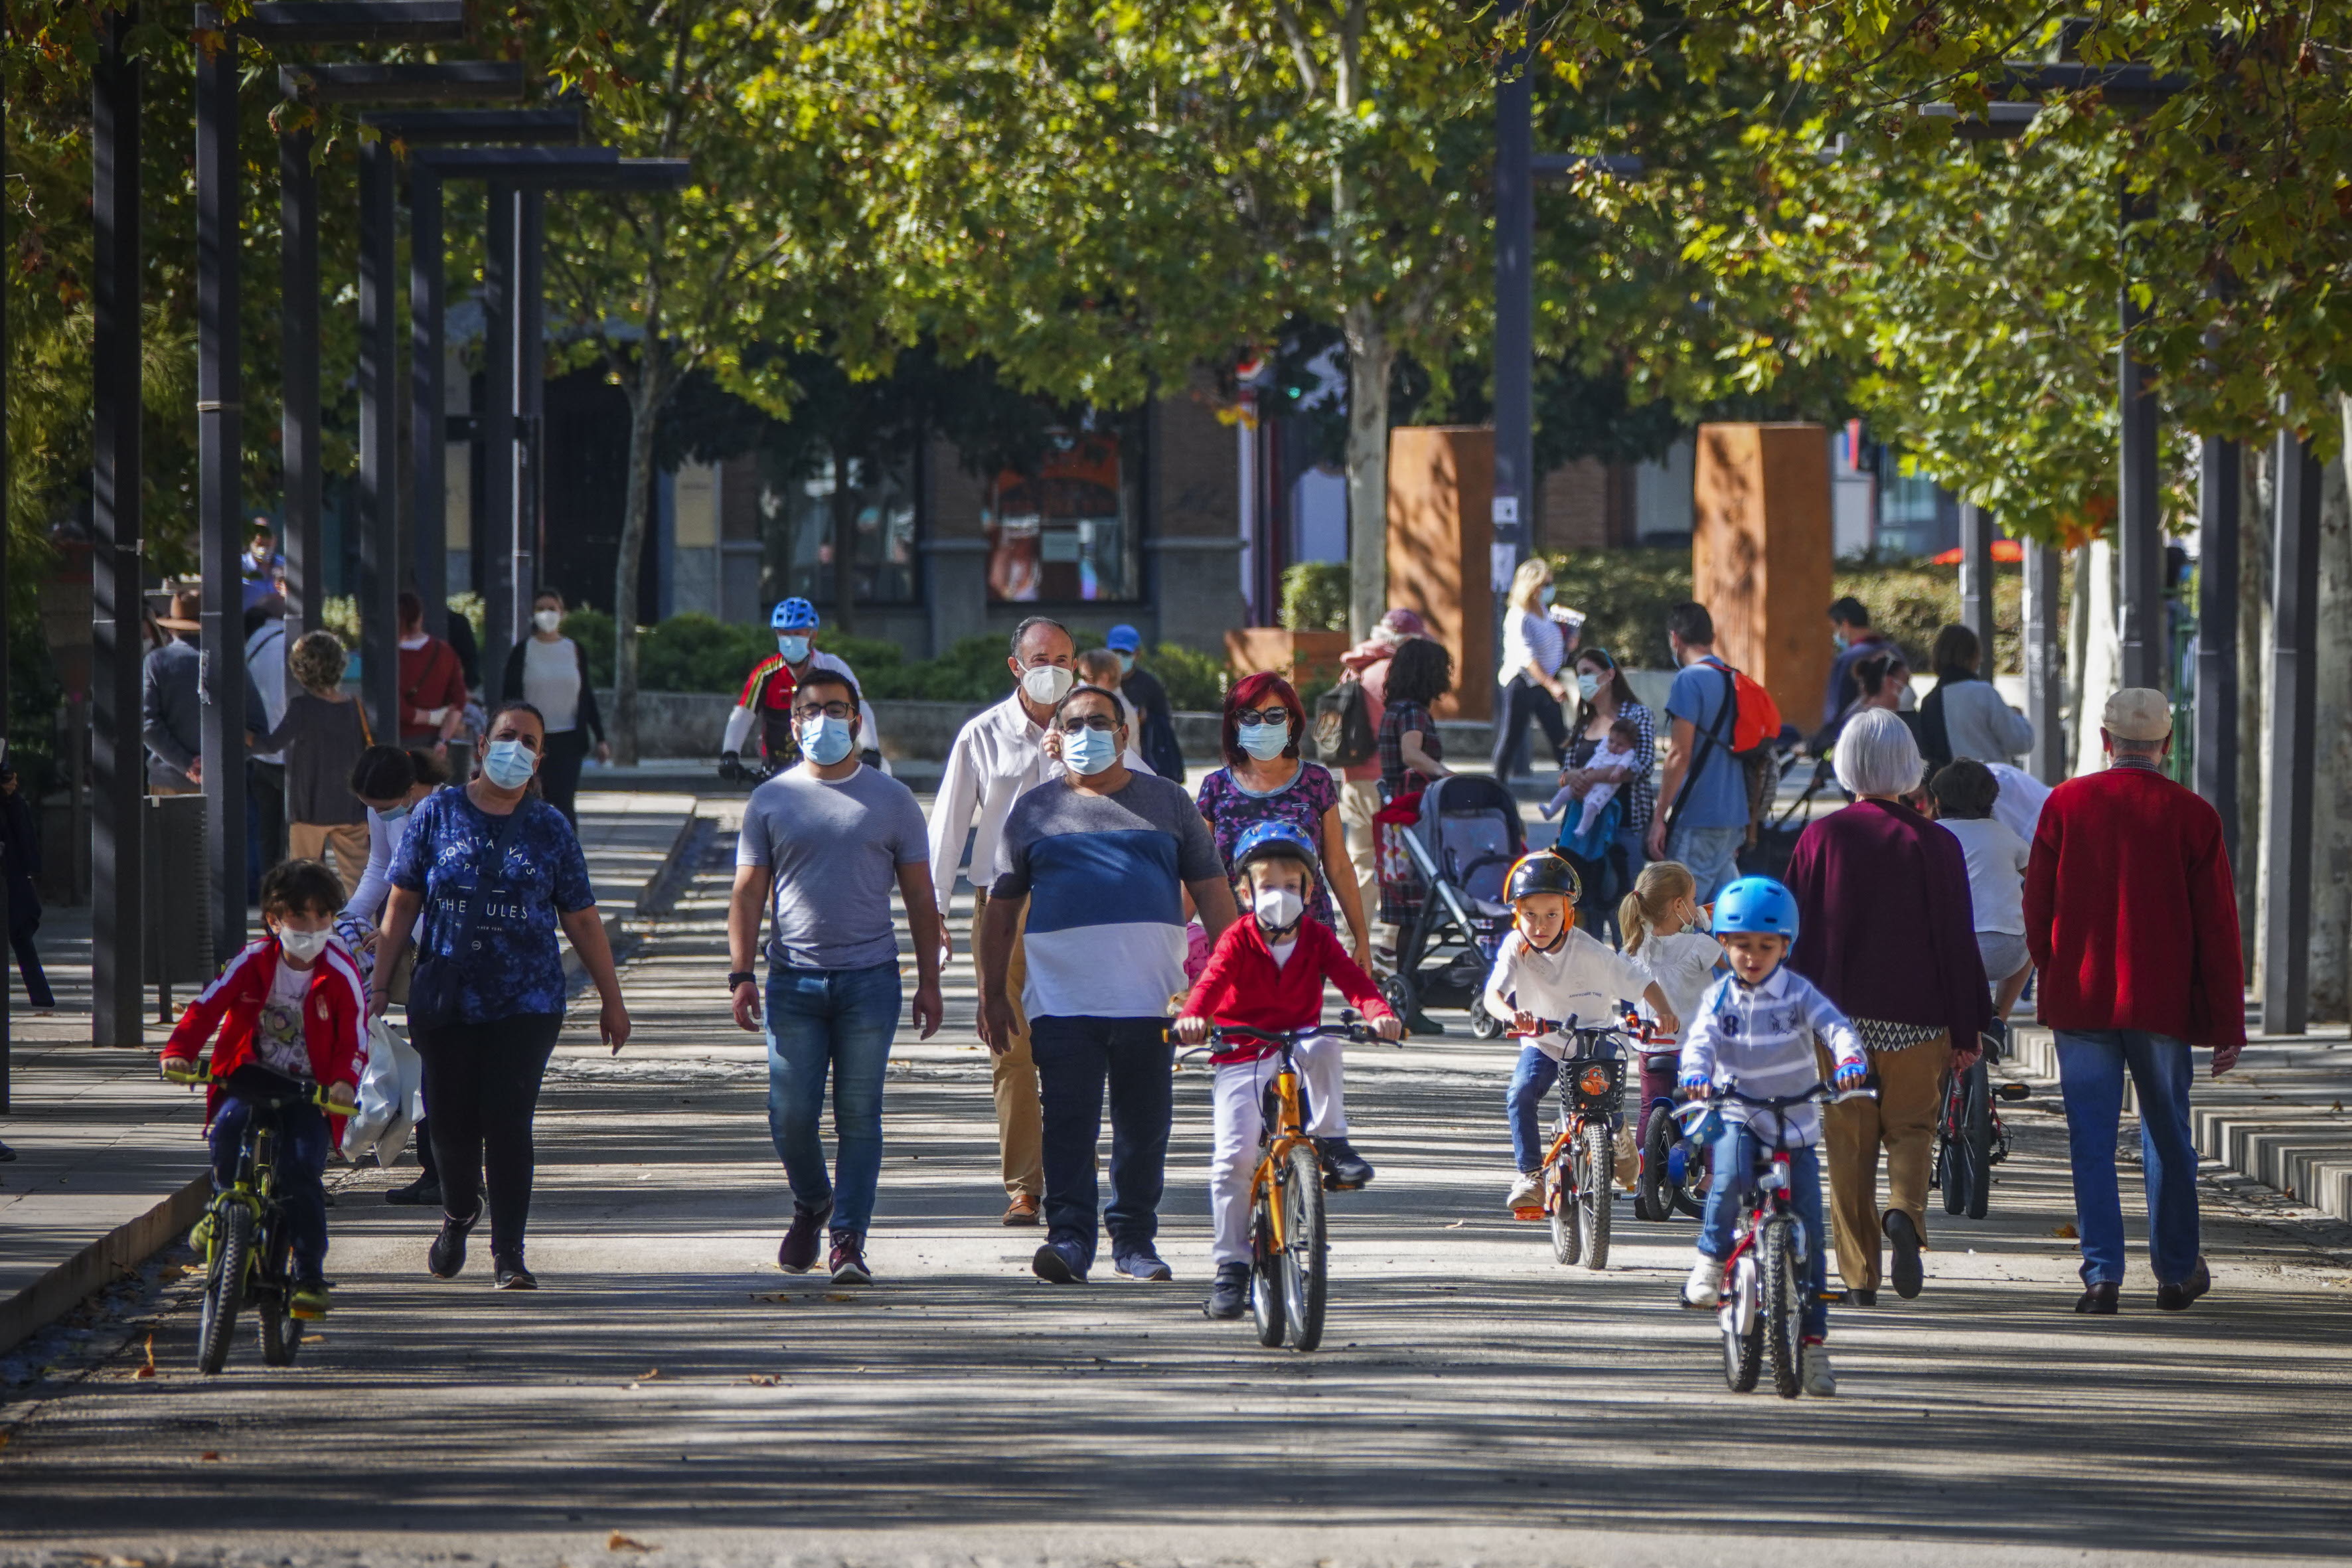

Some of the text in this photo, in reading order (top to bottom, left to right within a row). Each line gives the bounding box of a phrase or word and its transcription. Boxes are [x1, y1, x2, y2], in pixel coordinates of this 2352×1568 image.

[437, 836, 536, 875] DON'T AAYS
[464, 863, 503, 878] PLY
[436, 898, 528, 919] THE ULES
[1723, 1014, 1739, 1037] 8
